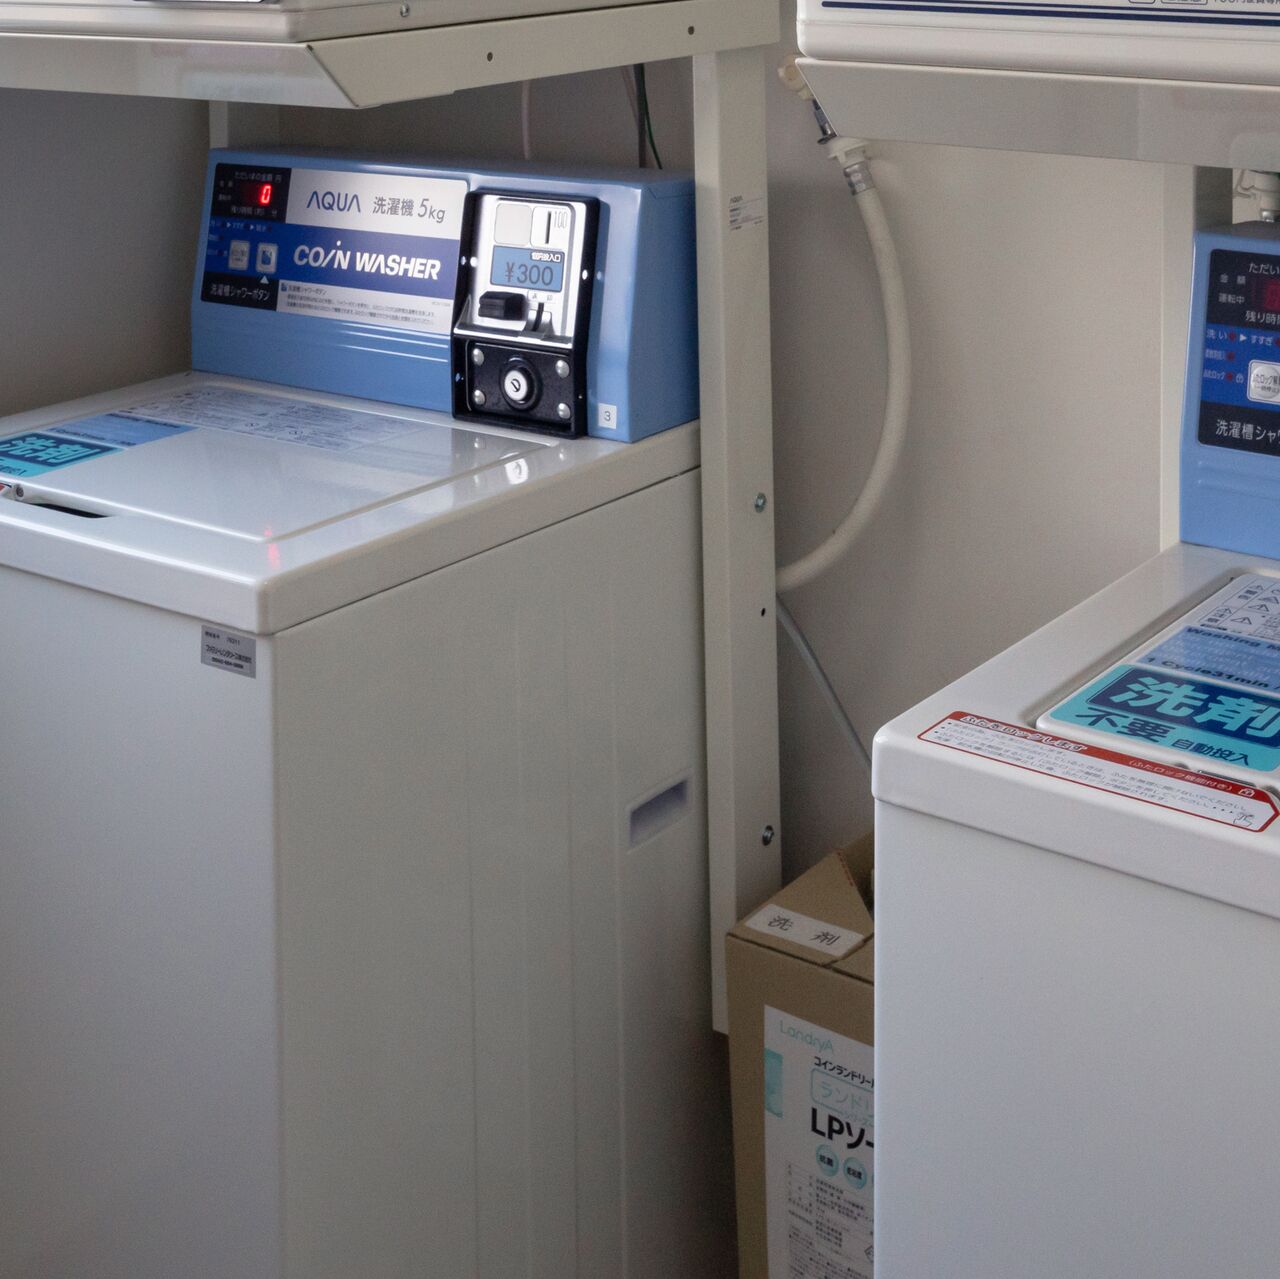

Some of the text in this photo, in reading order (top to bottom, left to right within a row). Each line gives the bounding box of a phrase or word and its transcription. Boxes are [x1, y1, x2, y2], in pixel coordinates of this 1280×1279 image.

[260, 184, 272, 204] 0
[307, 191, 445, 223] AQUA 洗濯機 5kg
[356, 251, 441, 280] WASHER
[505, 261, 553, 285] ¥300
[604, 411, 611, 422] 3
[1187, 627, 1262, 648] Washing
[1076, 707, 1249, 766] 不要 自動投入
